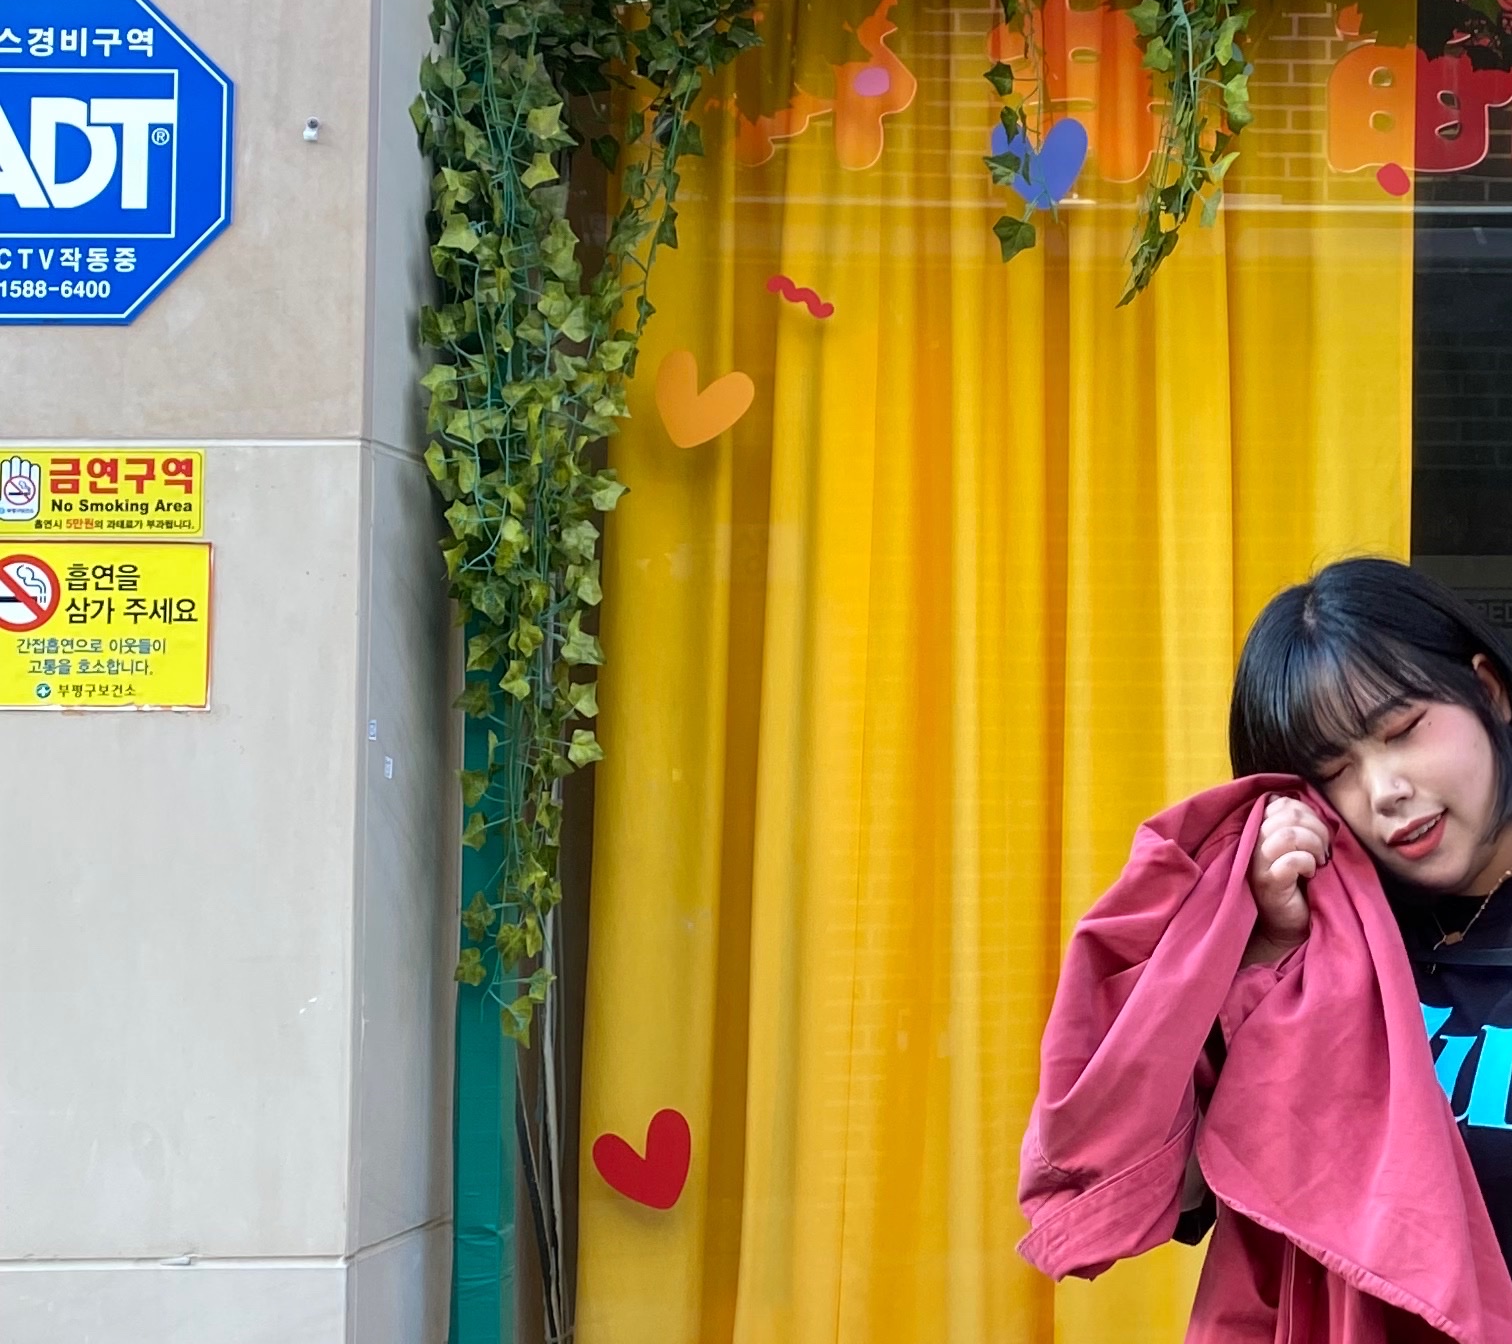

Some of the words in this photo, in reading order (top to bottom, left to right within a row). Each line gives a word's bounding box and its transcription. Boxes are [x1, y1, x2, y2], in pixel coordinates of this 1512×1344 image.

[0, 279, 111, 299] 1588-6400
[49, 457, 194, 495] 금연구역
[51, 499, 73, 512] No
[79, 499, 149, 516] Smoking
[154, 499, 193, 513] Area
[65, 563, 141, 592] 흡연을
[65, 597, 115, 625] 삼가
[123, 597, 199, 625] 주세요
[16, 637, 104, 655] 간접흡연으로
[109, 637, 167, 655] 이웃들이
[28, 658, 72, 676] 고통을
[76, 658, 154, 676] 호소합니다.
[58, 683, 136, 698] 부평구보건소
